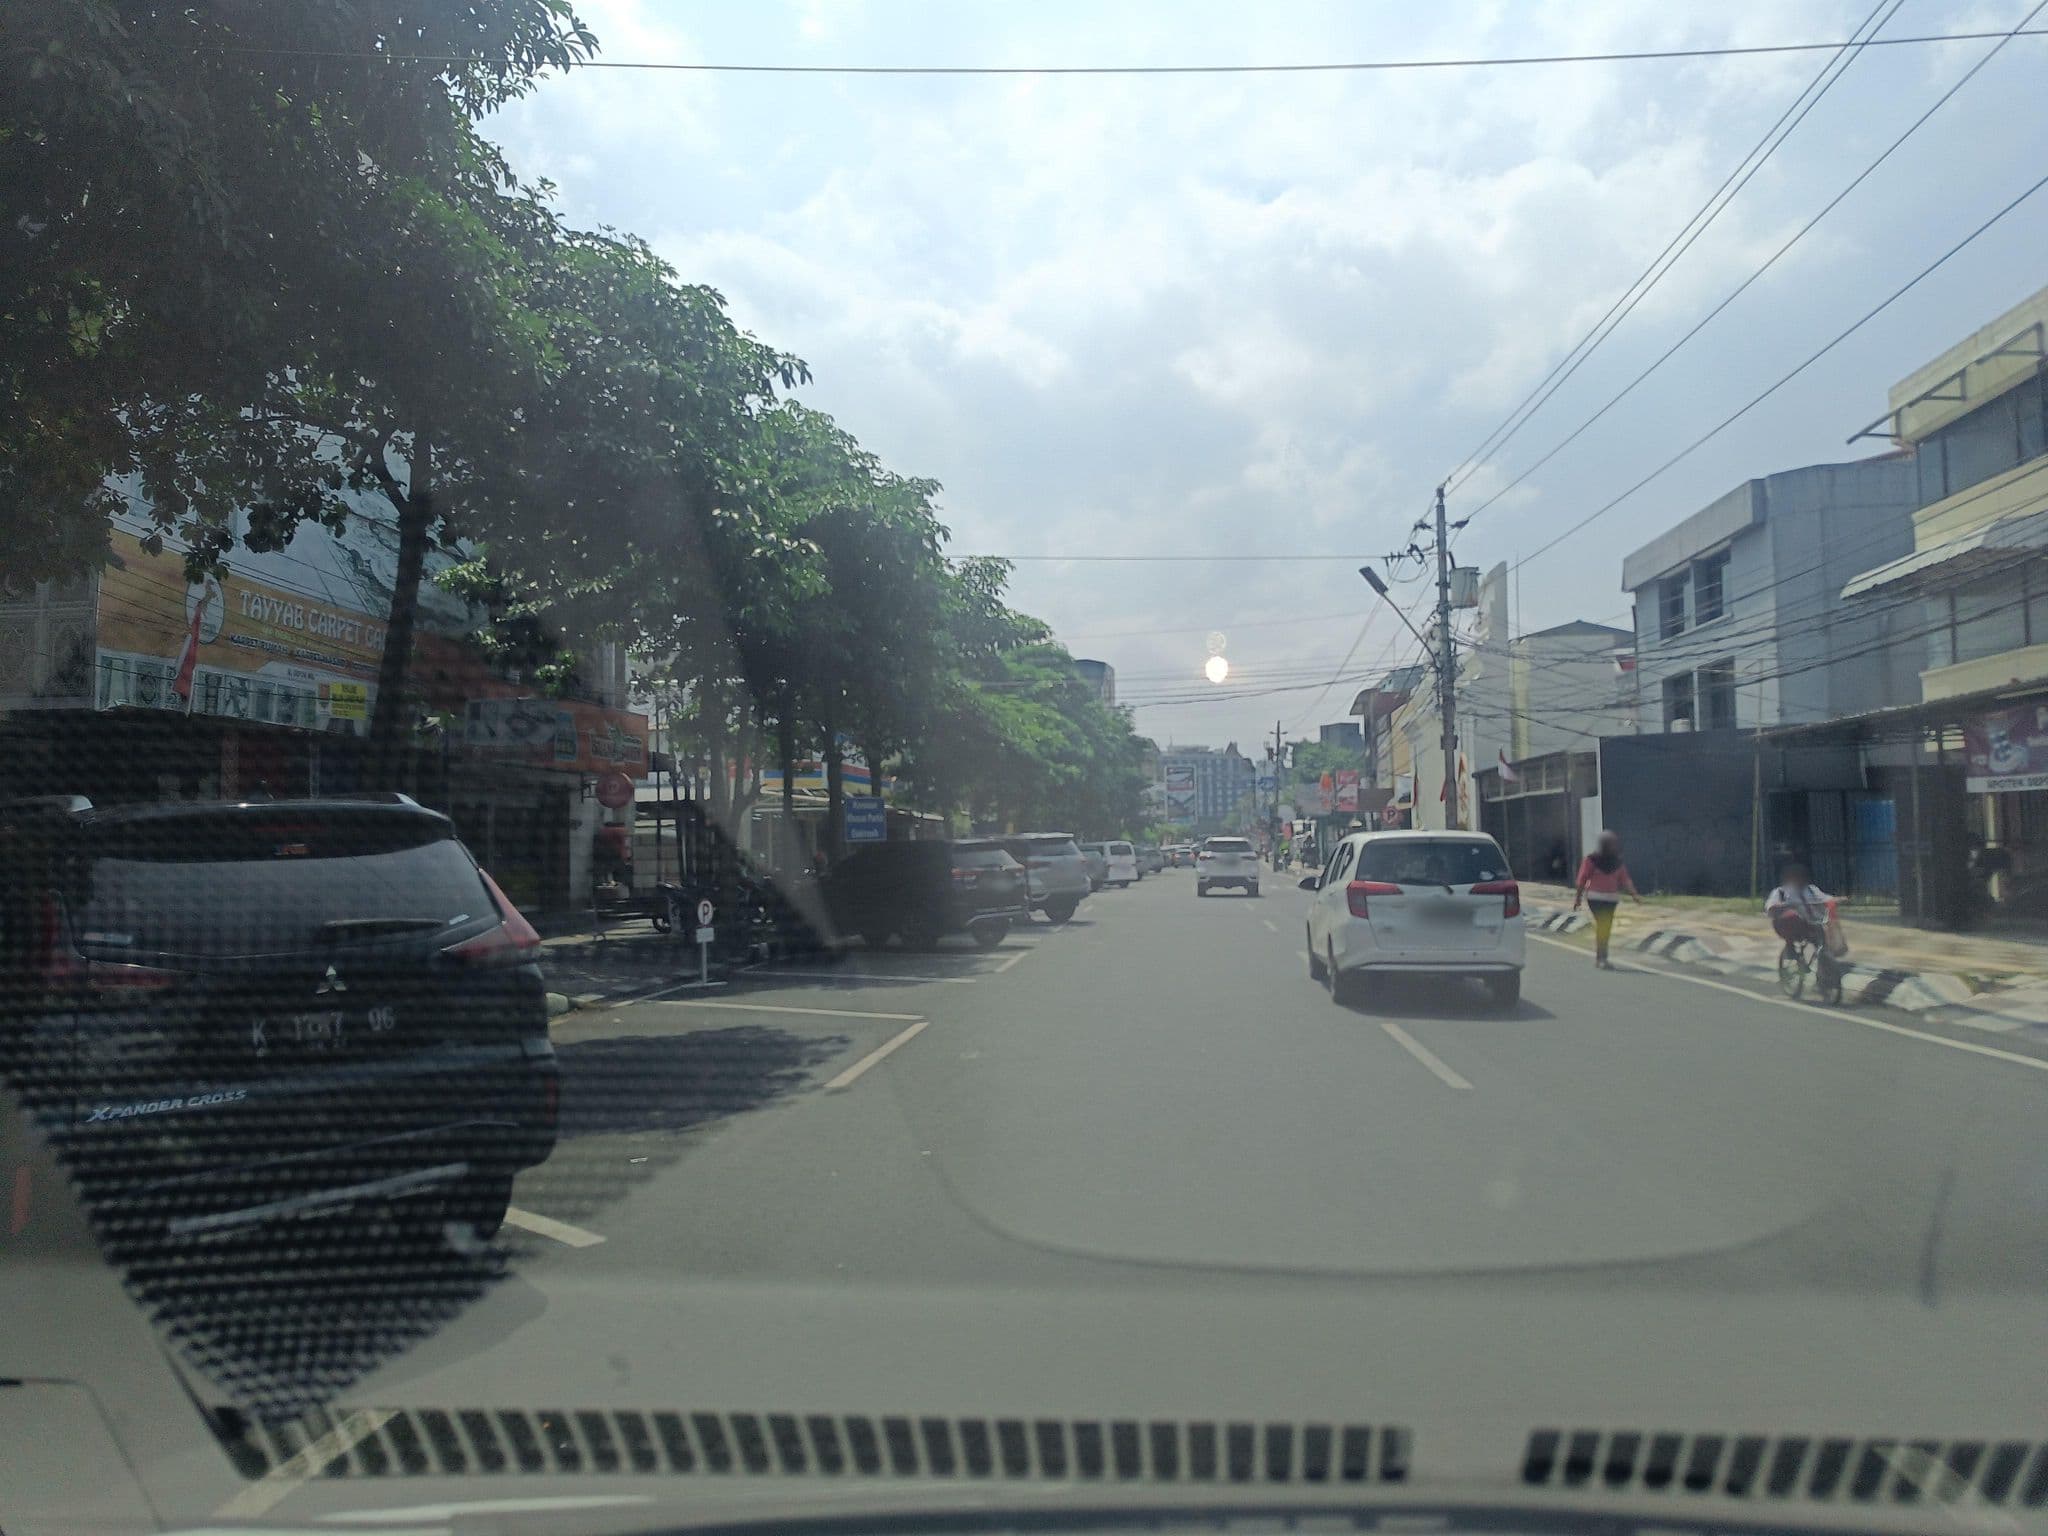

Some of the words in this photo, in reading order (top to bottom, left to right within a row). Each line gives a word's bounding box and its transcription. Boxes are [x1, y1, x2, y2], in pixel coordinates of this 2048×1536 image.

[239, 589, 305, 630] TAYYAB
[307, 608, 362, 645] CARPET
[86, 1097, 183, 1123] XPANDER
[187, 1087, 249, 1107] CROSS
